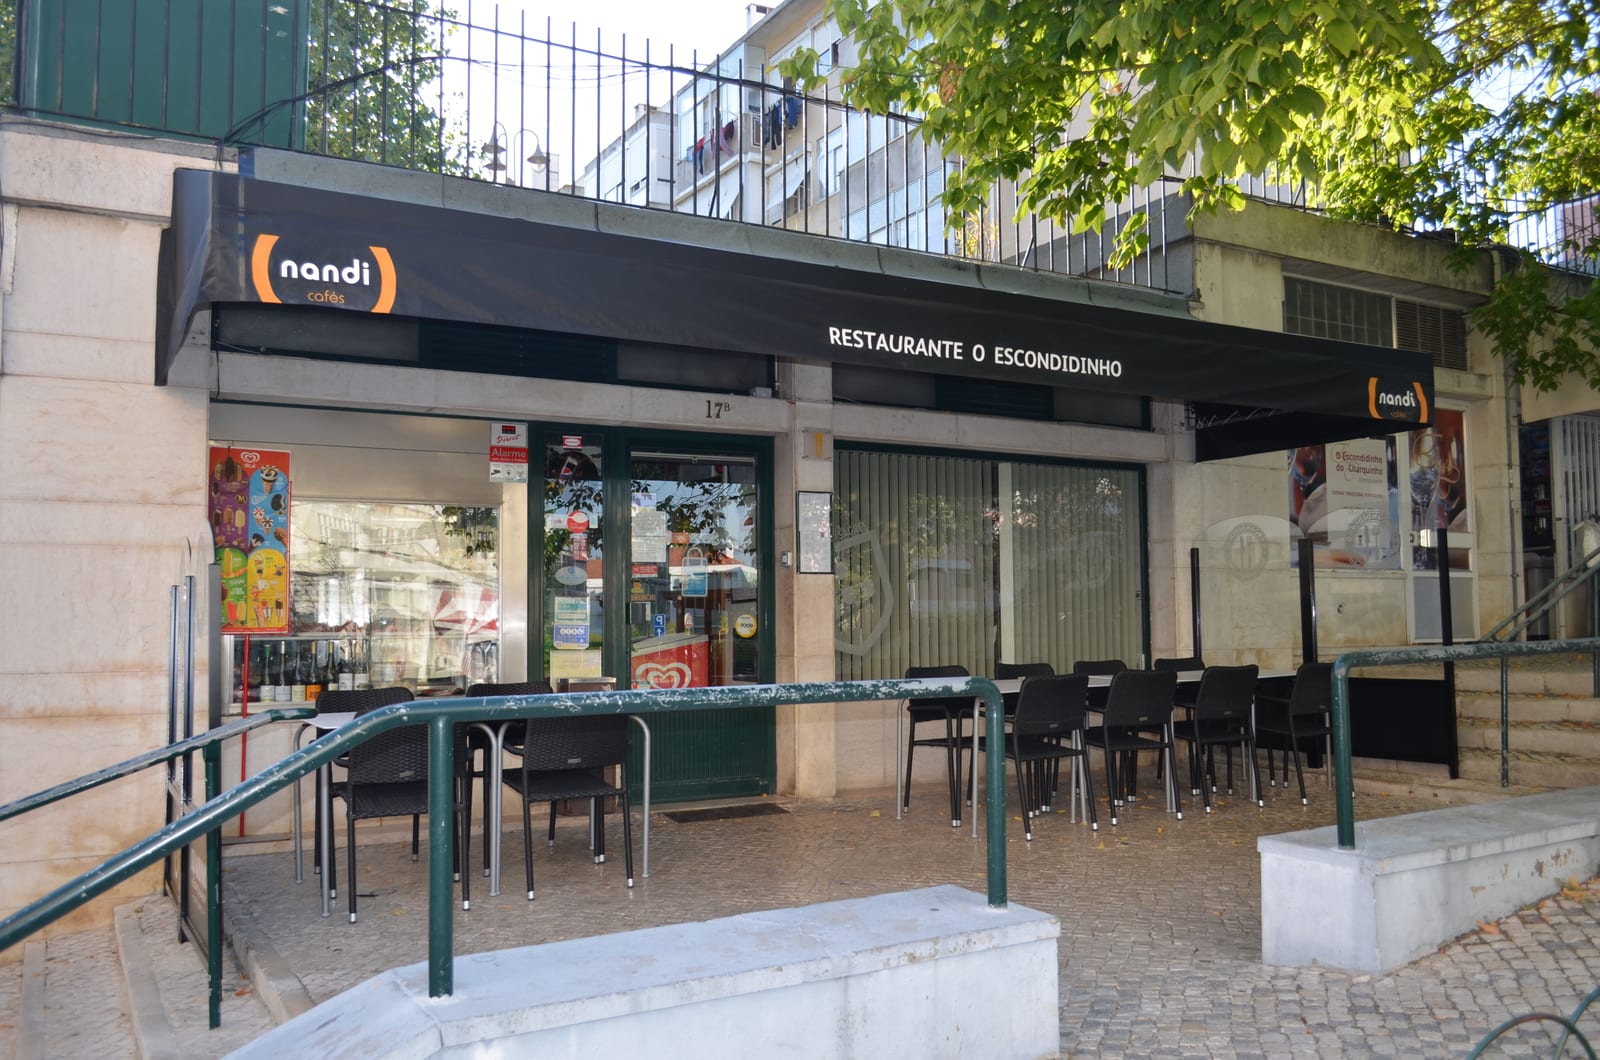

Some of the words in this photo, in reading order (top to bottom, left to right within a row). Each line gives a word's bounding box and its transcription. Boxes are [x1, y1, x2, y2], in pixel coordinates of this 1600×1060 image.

[280, 258, 370, 286] nandi
[307, 290, 345, 304] cafés
[829, 327, 963, 360] RESTAURANTE
[972, 344, 986, 362] O
[994, 346, 1122, 378] ESCONDIDINHO
[1378, 390, 1416, 407] nandi
[491, 447, 526, 457] Alarme
[1341, 451, 1383, 464] Escondidinho
[1347, 464, 1384, 476] Charquinho
